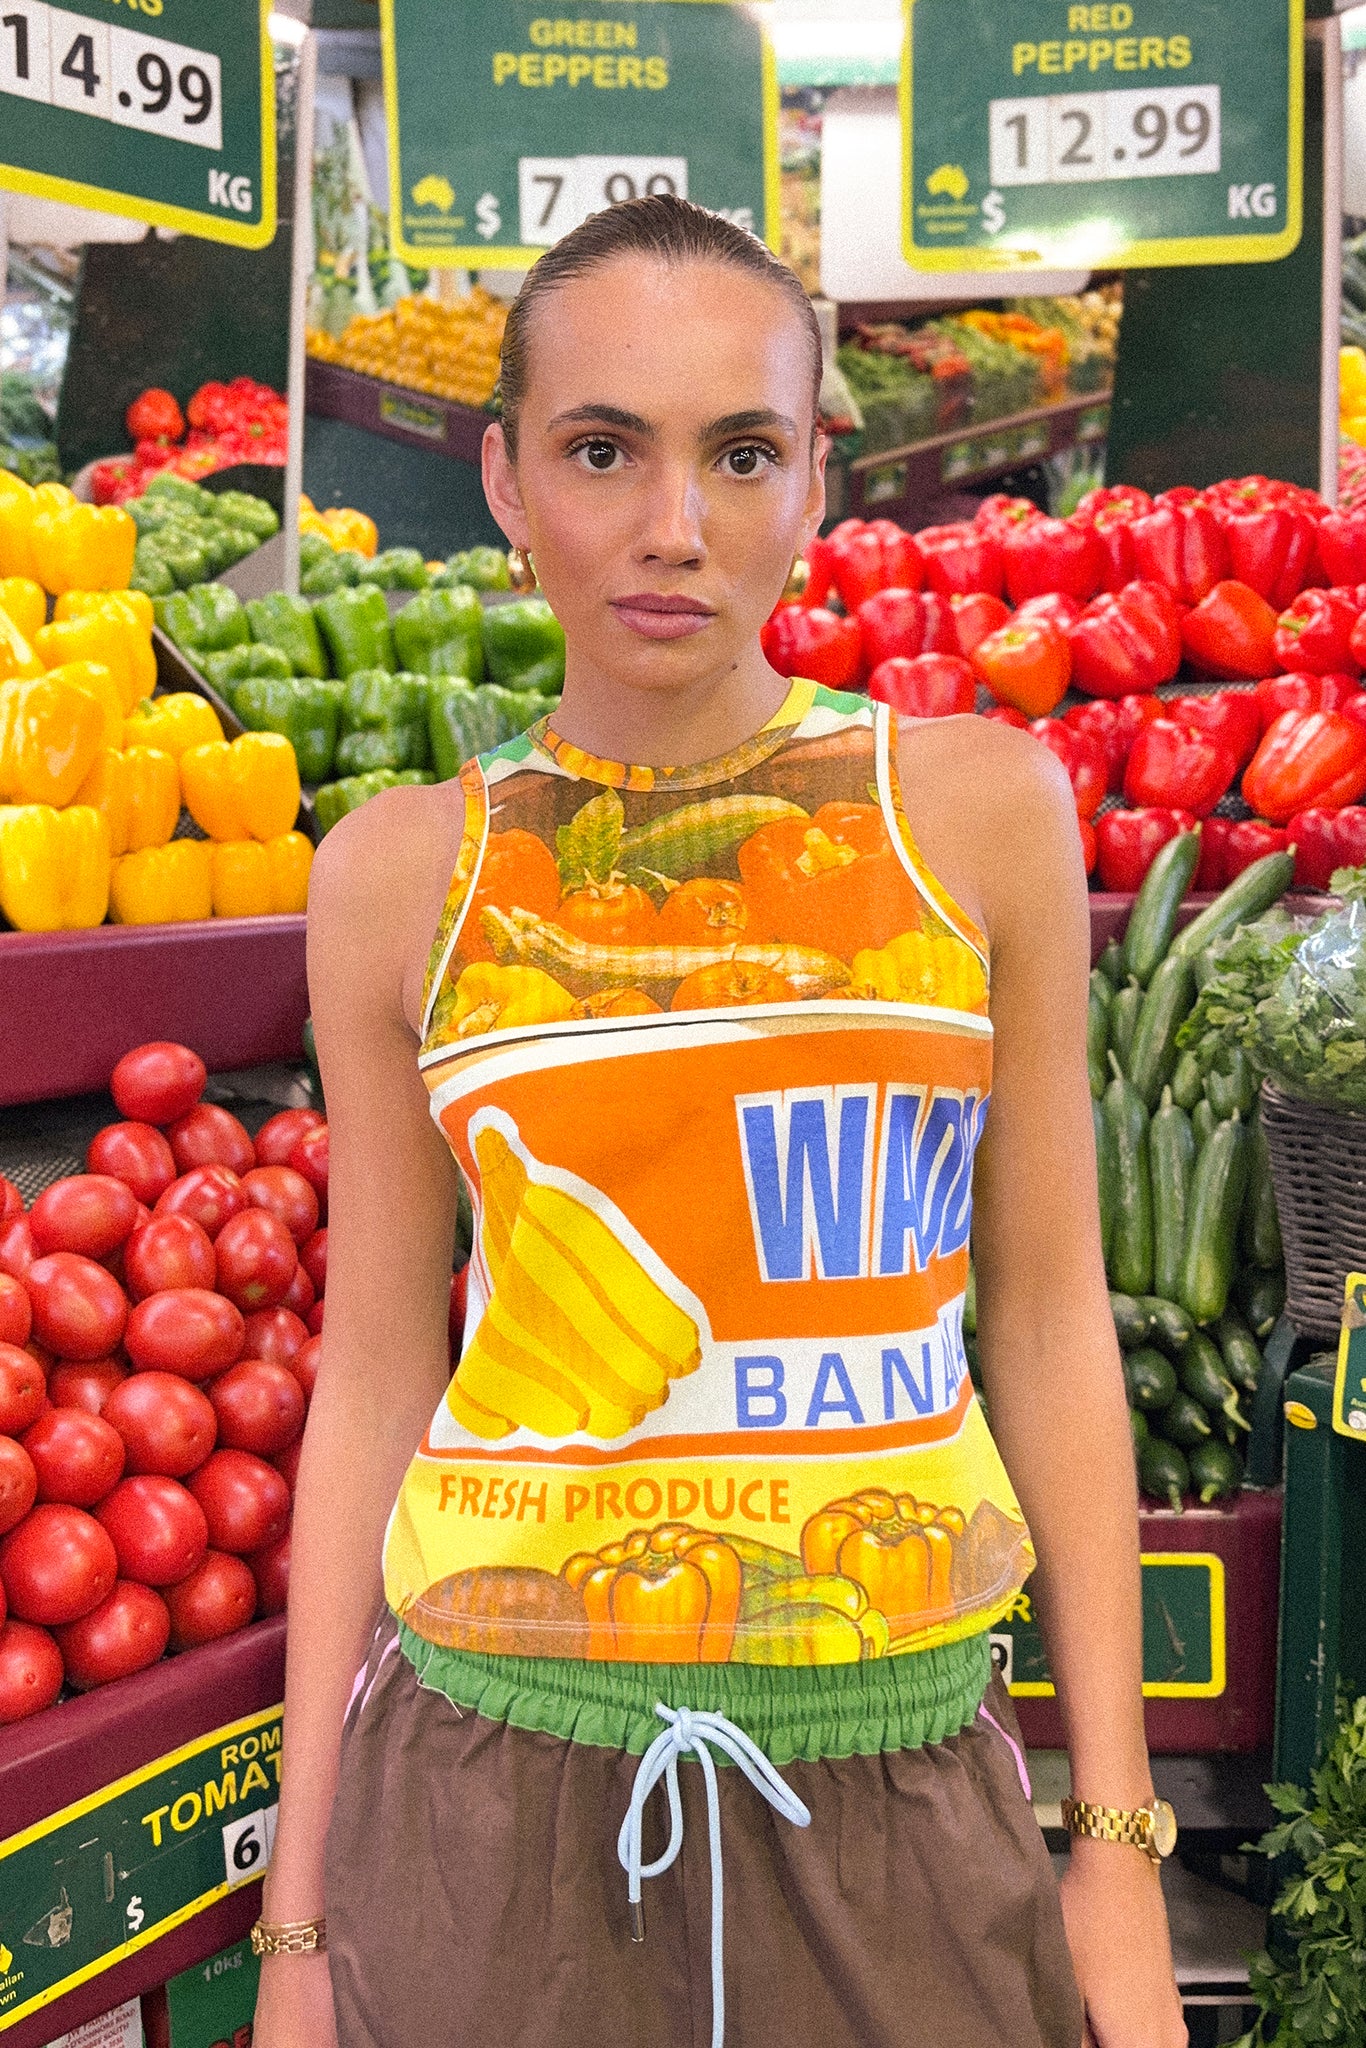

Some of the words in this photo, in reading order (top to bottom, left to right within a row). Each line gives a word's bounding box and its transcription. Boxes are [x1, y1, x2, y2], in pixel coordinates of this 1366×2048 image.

[529, 17, 638, 49] GREEN
[1067, 3, 1134, 33] RED
[2, 14, 213, 126] 14.99
[492, 51, 669, 90] PEPPERS
[1011, 34, 1193, 77] PEPPERS
[1005, 101, 1211, 168] 12.99
[208, 168, 252, 213] KG
[980, 189, 1006, 235] $
[1226, 182, 1278, 220] KG
[475, 191, 501, 241] $
[438, 1474, 548, 1524] FRESH
[565, 1477, 791, 1524] PRODUCE
[233, 1824, 261, 1870] 6
[126, 1896, 145, 1931] $
